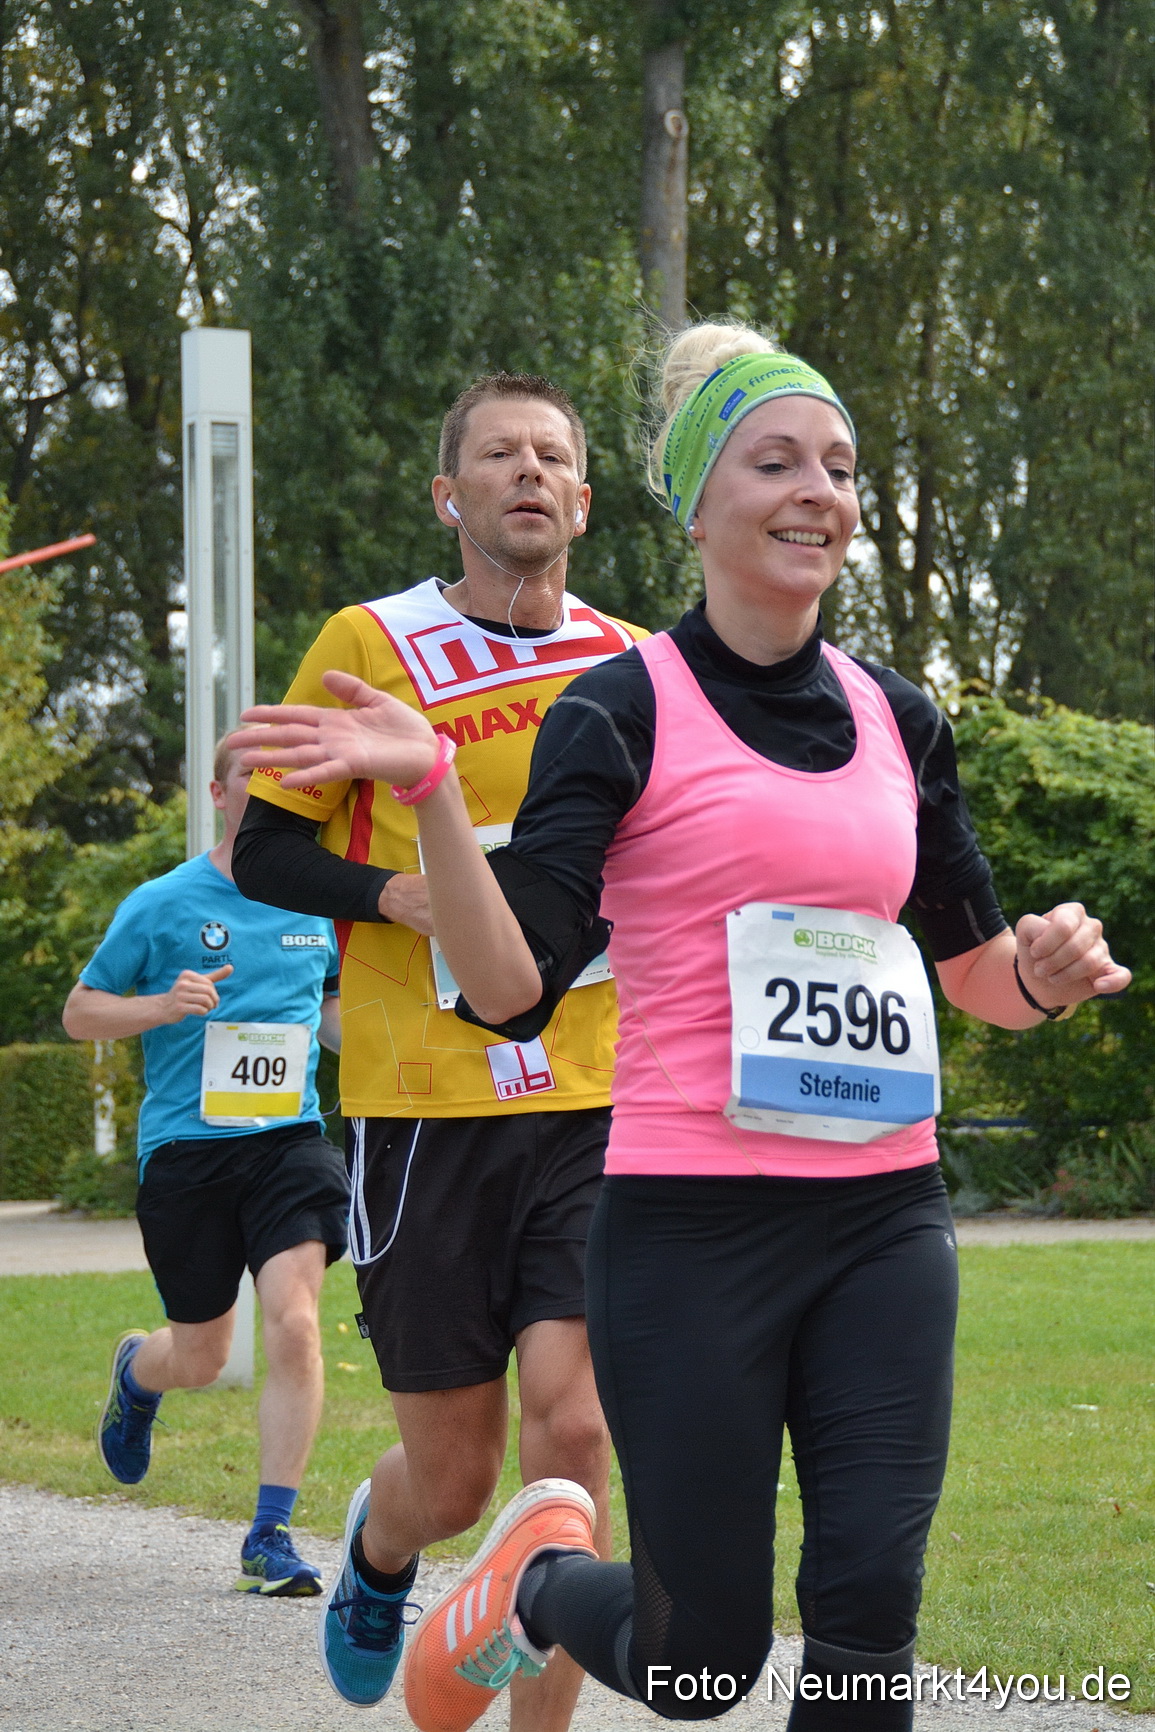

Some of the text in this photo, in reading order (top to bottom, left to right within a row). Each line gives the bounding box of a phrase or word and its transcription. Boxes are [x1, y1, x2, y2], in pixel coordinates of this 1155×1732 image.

[433, 697, 543, 748] MAX
[280, 933, 328, 947] BOCK
[815, 929, 877, 958] BOCK
[202, 954, 232, 964] PARTL
[764, 976, 912, 1056] 2596
[231, 1055, 287, 1087] 409
[799, 1071, 881, 1104] Stefanie
